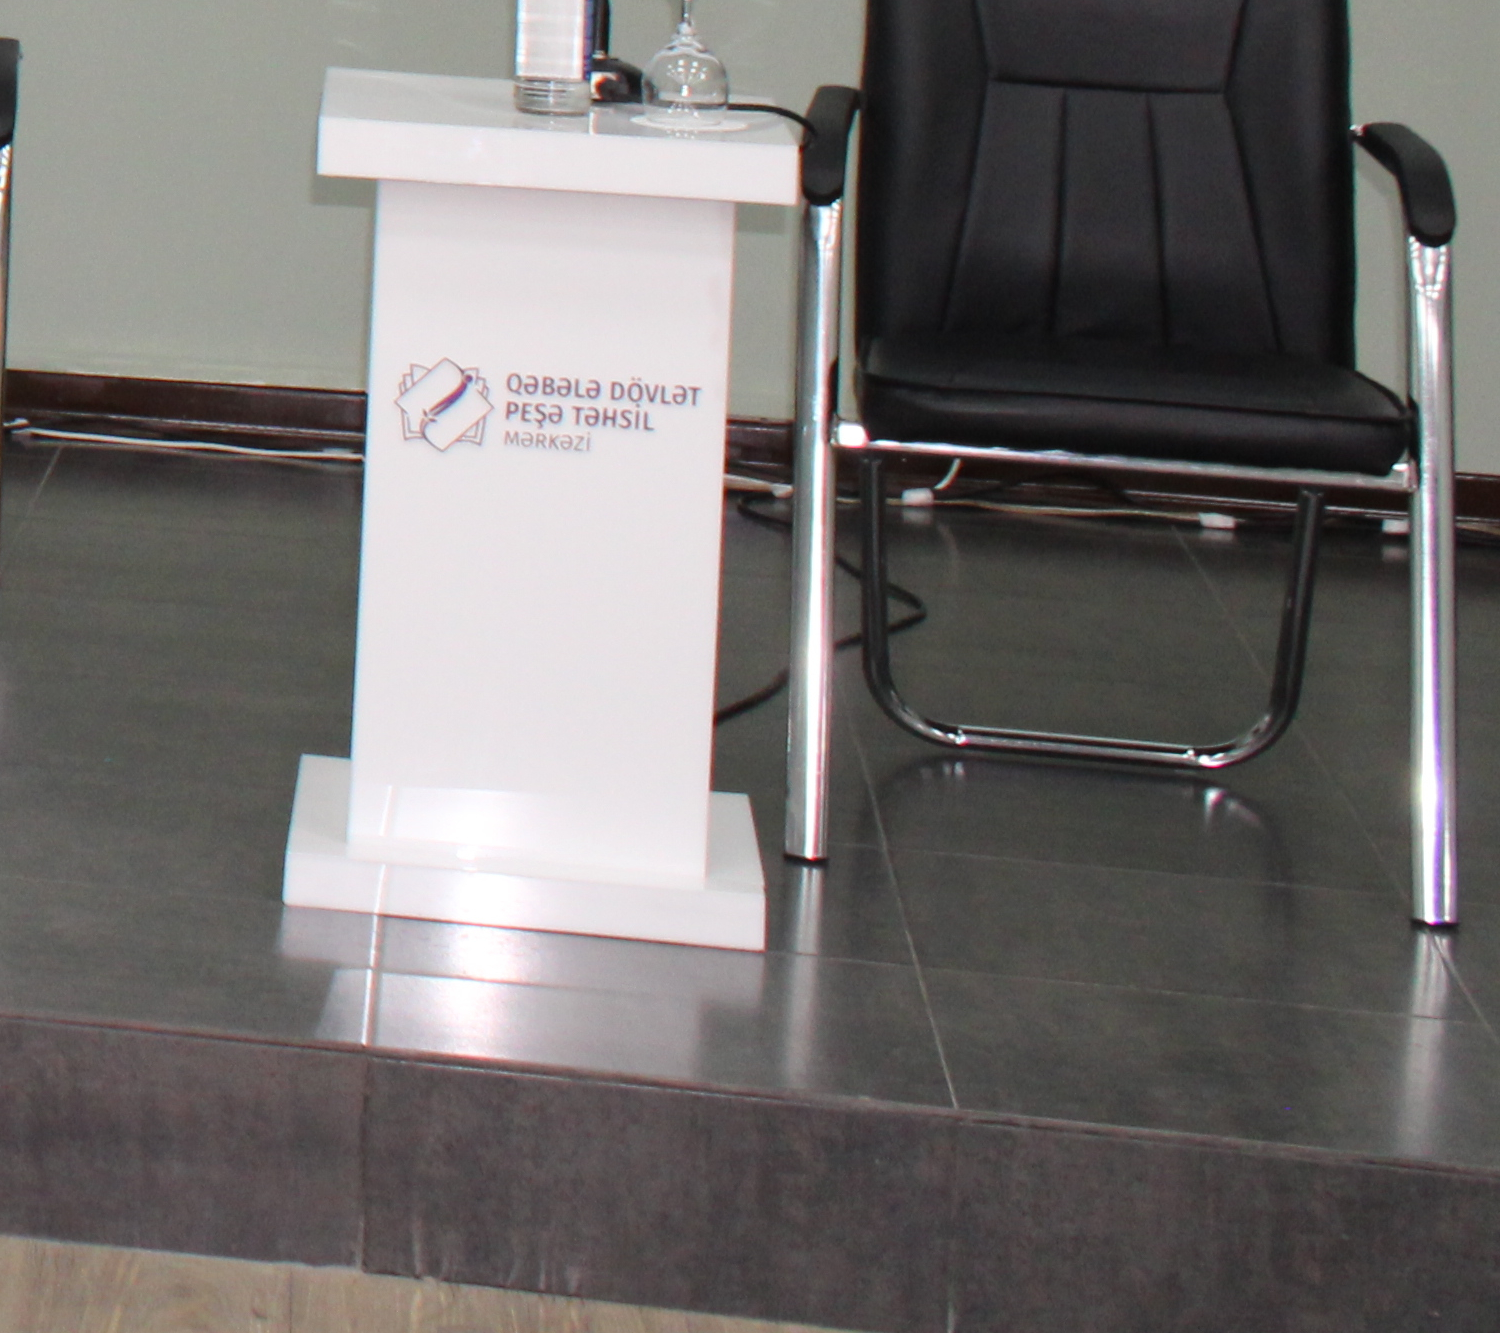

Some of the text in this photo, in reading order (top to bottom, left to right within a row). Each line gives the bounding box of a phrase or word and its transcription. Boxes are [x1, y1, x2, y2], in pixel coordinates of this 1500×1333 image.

[505, 372, 703, 407] QƏBƏLƏ DÖVLƏT
[504, 401, 656, 432] PEŞƏ TƏHSİL
[503, 430, 592, 452] MƏRKƏZİ
